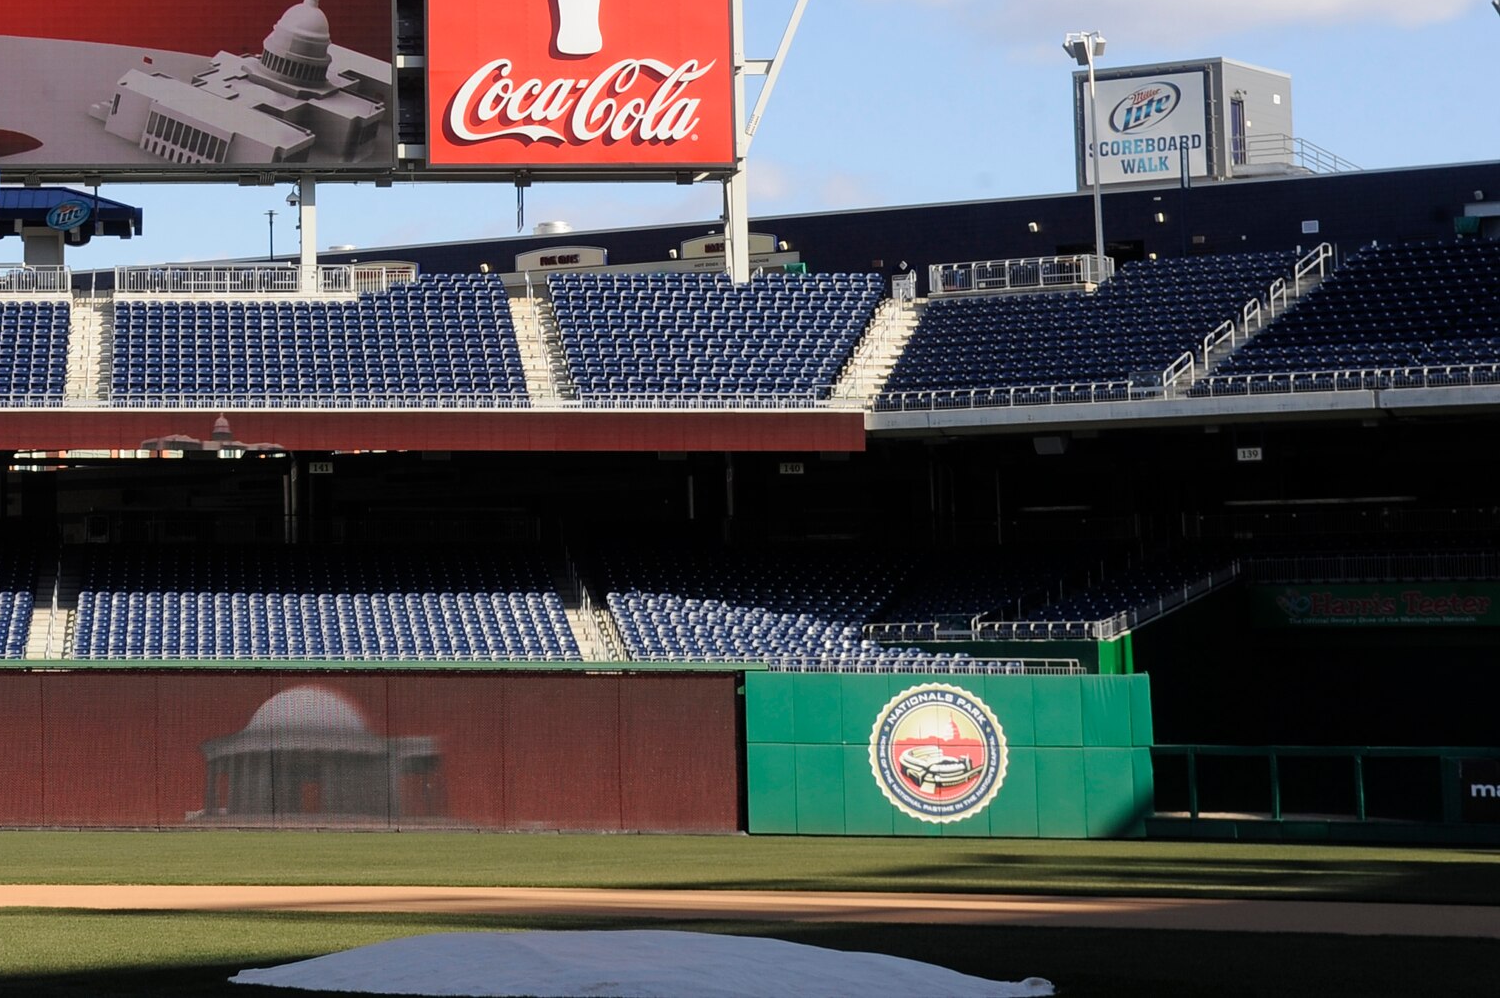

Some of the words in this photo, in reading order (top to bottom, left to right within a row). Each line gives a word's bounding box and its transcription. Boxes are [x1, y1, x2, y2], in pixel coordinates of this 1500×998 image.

[450, 58, 717, 142] Coca-Cola
[1128, 88, 1161, 106] Miller
[1122, 94, 1171, 132] Lite
[1089, 134, 1202, 158] SCOREBOARD
[1120, 156, 1170, 174] WALK
[1241, 449, 1259, 459] 139
[314, 463, 329, 472] 141
[784, 464, 801, 472] 140
[1309, 590, 1397, 616] Harris
[1400, 589, 1492, 616] Teeter
[887, 692, 954, 725] NATIONALS
[956, 697, 987, 725] PARK
